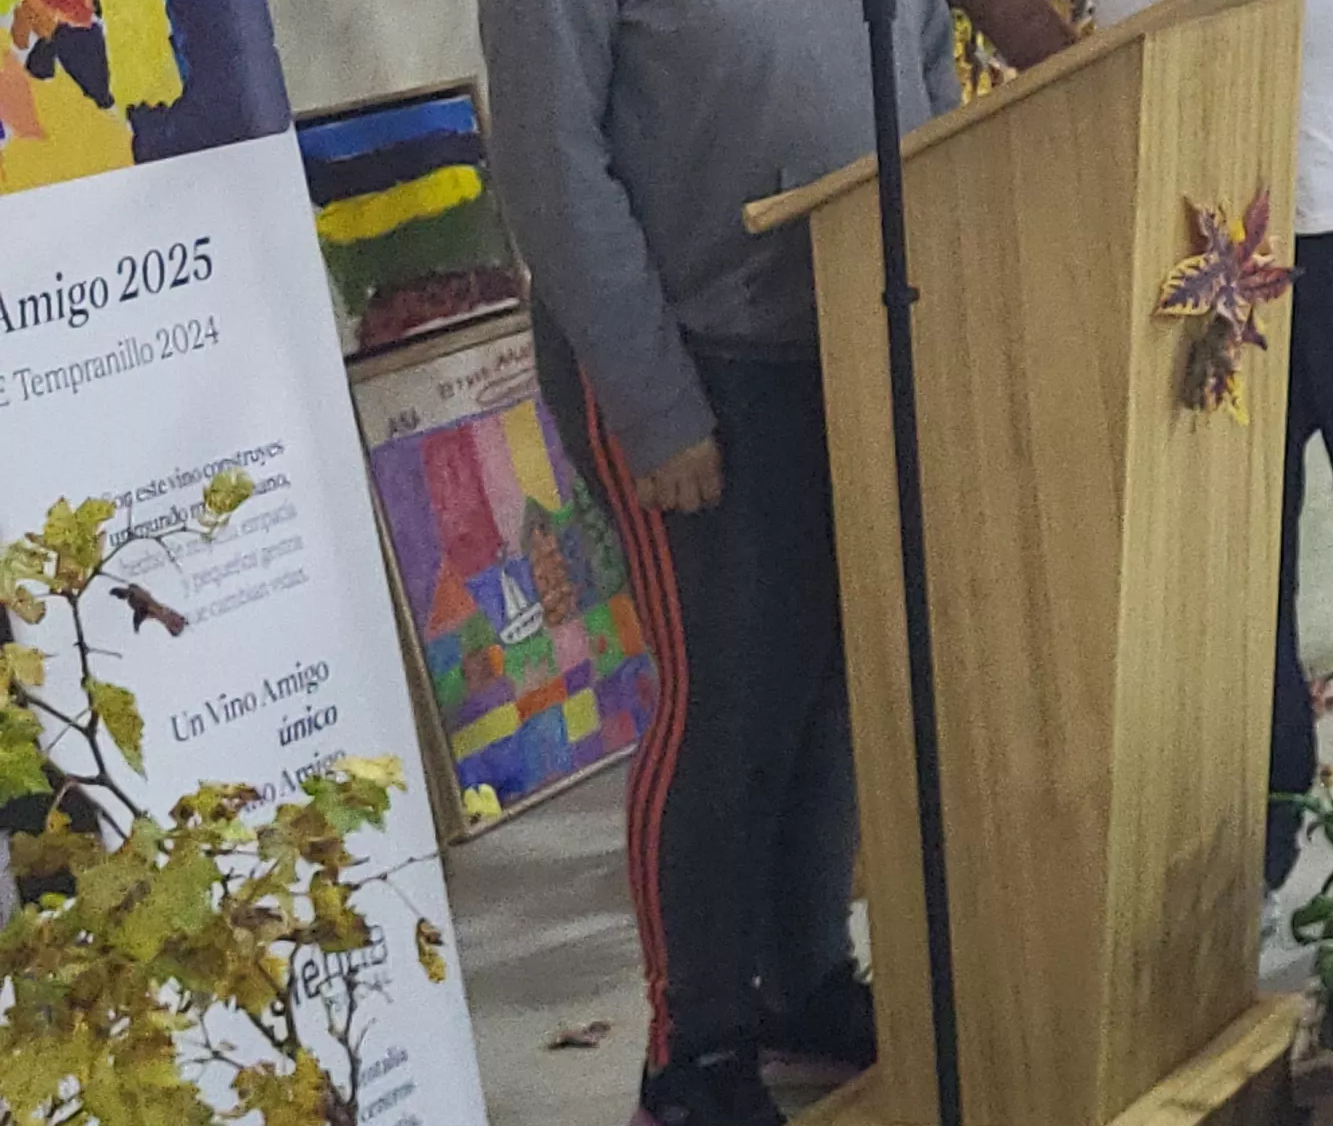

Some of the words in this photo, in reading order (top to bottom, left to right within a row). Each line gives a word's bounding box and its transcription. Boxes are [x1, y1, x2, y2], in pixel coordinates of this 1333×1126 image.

[116, 236, 213, 302] 2025
[13, 336, 154, 402] Tempranillo
[155, 315, 220, 360] 2024
[170, 710, 206, 742] Un
[205, 693, 257, 725] Vino
[261, 661, 330, 707] Amigo
[278, 705, 338, 747] único
